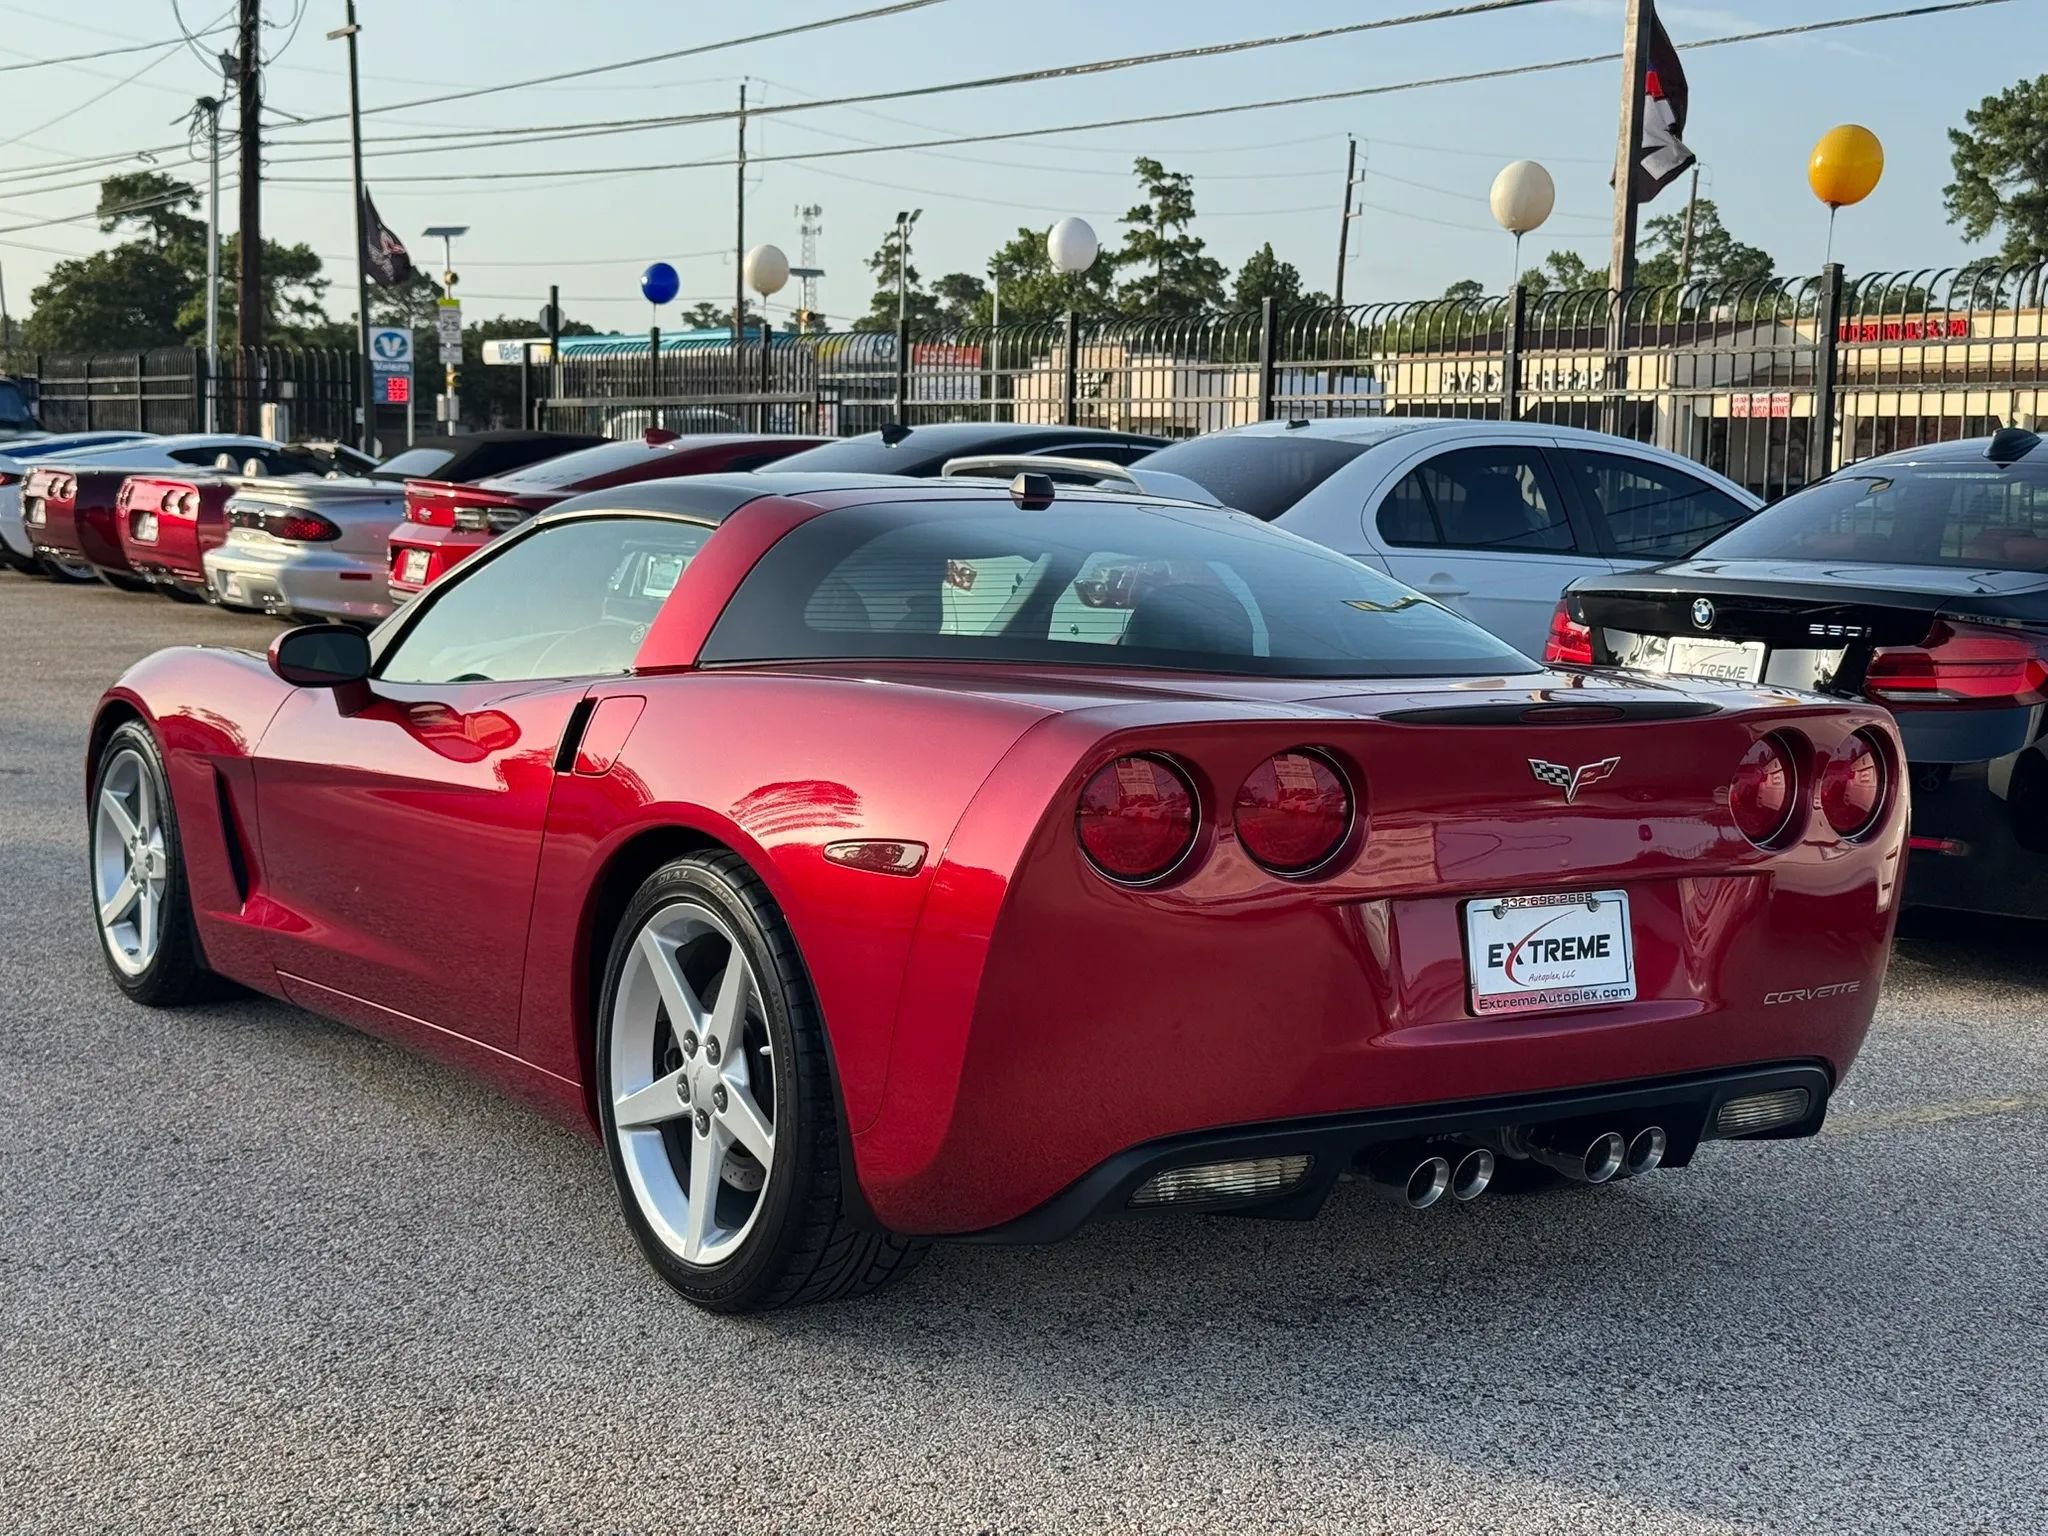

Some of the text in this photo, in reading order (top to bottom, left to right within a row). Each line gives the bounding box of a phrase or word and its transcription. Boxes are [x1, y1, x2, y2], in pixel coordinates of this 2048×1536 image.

[1488, 934, 1610, 968] EXTREME
[1562, 969, 1577, 979] LLC
[1479, 987, 1631, 1010] ExtremeAutoplex.com
[1763, 980, 1861, 1005] CORVETTE
